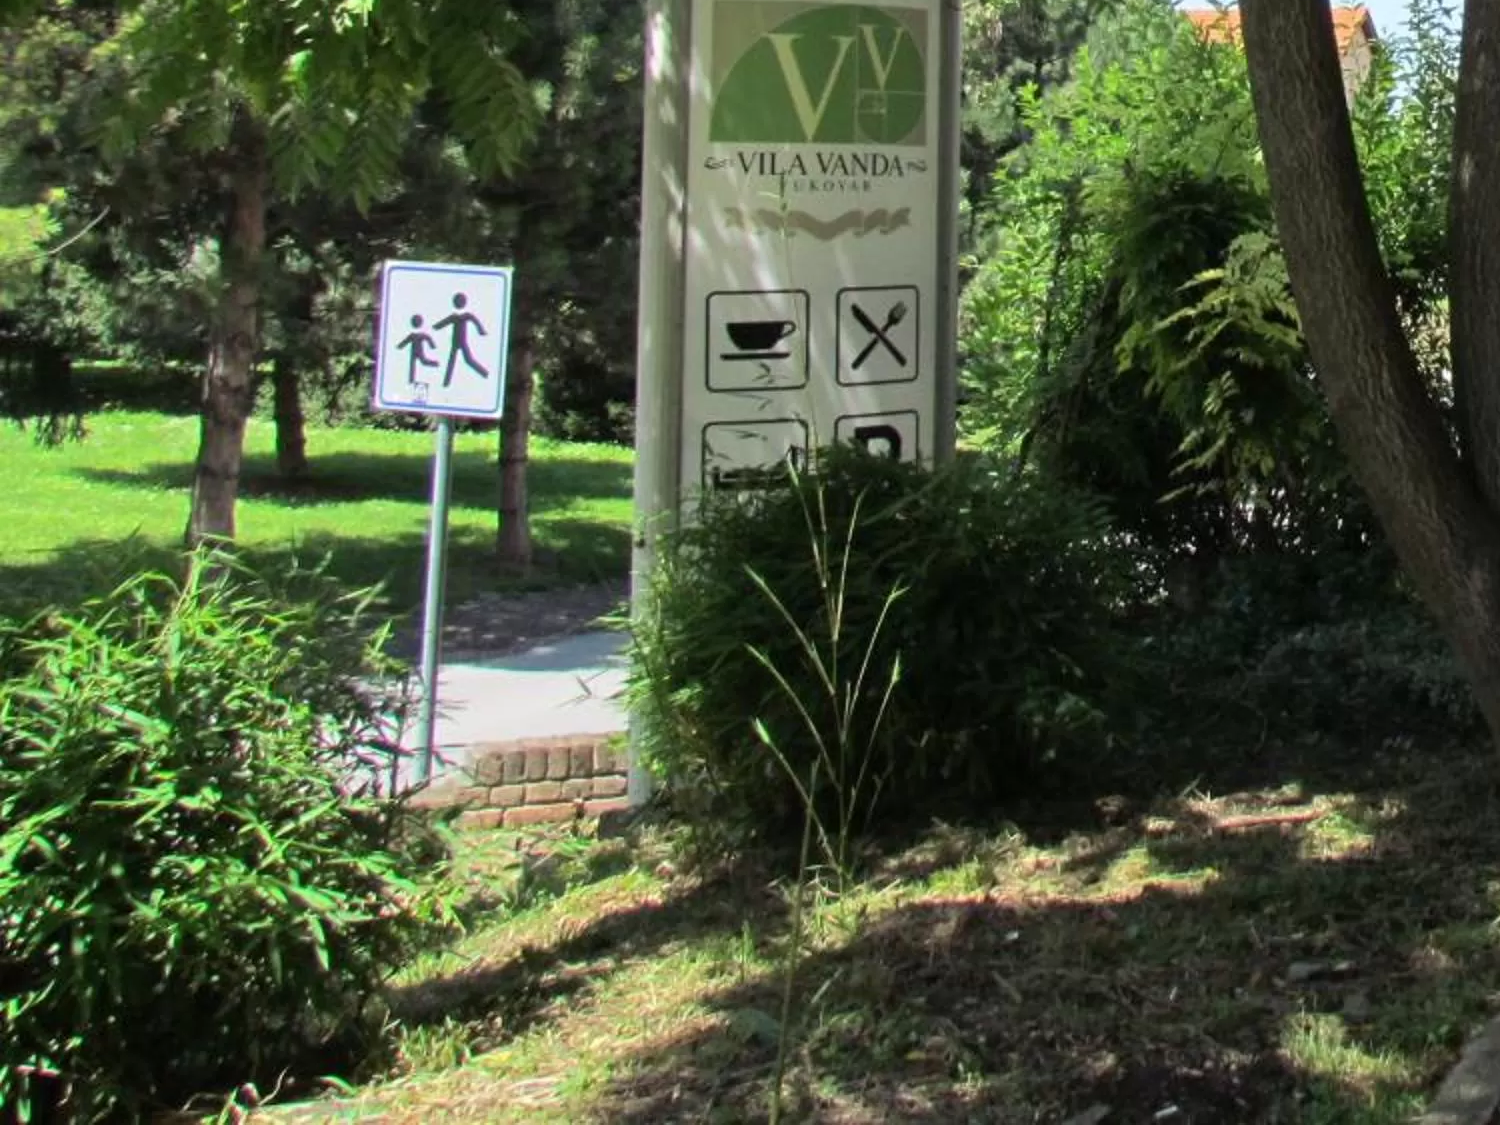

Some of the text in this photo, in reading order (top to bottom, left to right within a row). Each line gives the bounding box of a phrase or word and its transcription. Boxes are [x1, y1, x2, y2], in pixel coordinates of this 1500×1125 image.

[737, 151, 905, 177] VILA VANDA
[778, 178, 872, 193] UKOVAR
